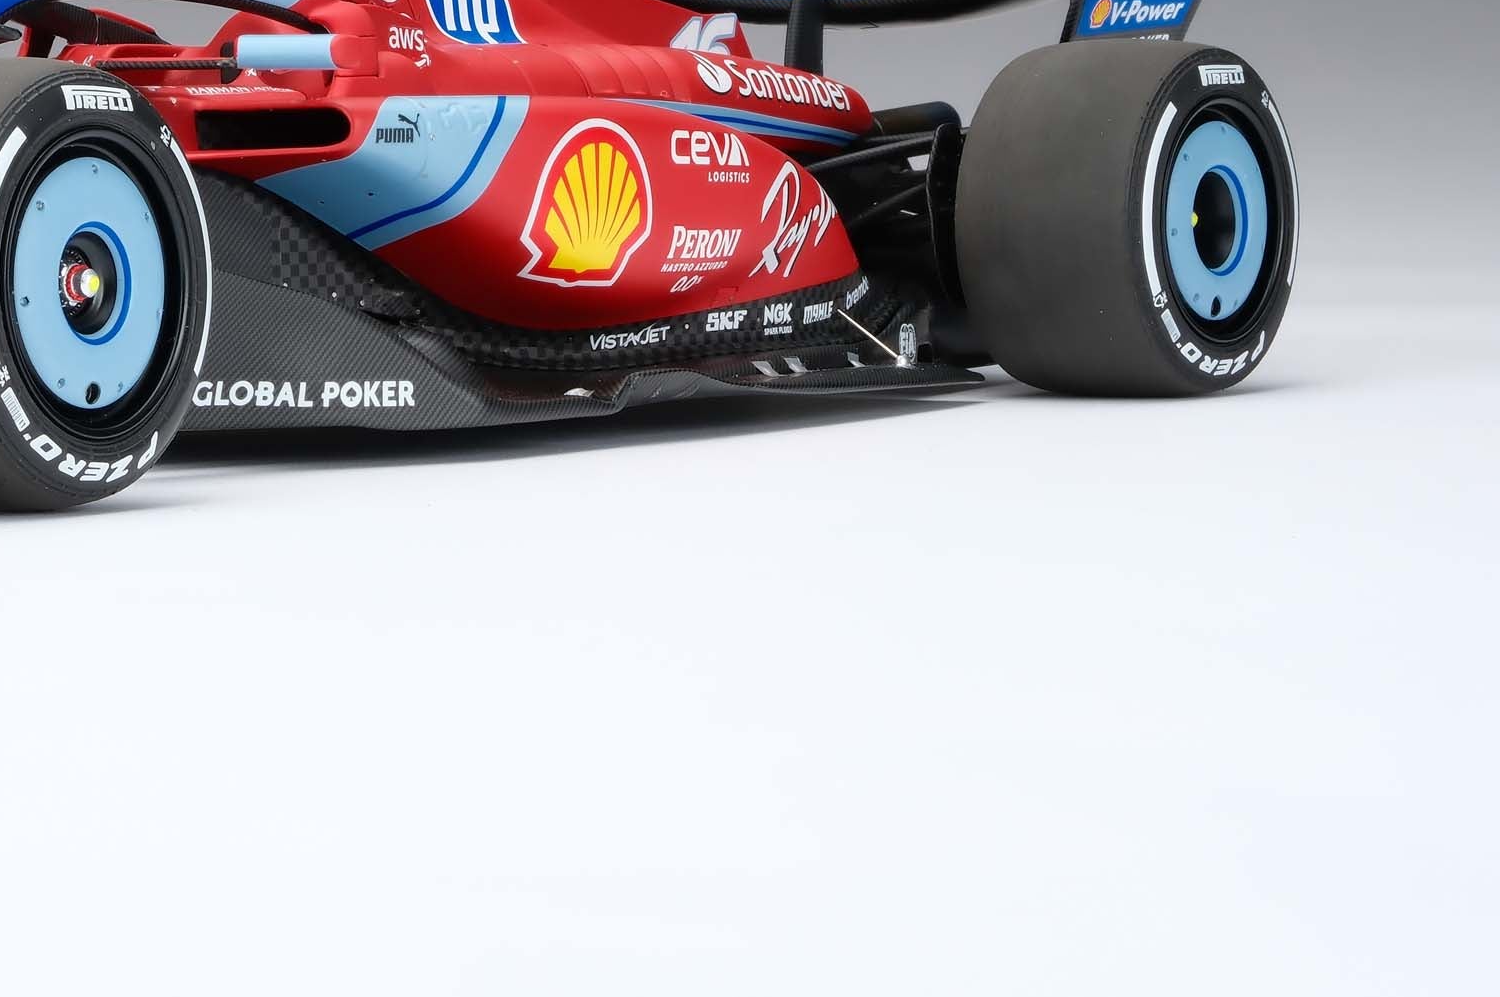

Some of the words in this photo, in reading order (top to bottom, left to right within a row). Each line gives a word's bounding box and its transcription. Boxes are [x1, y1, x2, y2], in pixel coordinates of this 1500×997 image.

[1110, 0, 1186, 26] V-Power
[388, 26, 425, 52] aws
[723, 59, 851, 112] Santander
[1198, 64, 1246, 87] PIRELLI
[60, 84, 134, 112] PIRELLI
[375, 127, 414, 144] PUMA
[707, 171, 750, 184] LOGISTICS
[666, 226, 742, 260] PERONI
[660, 263, 694, 273] NASTRO
[694, 260, 729, 272] AZZURRO
[705, 309, 748, 332] SKF
[763, 302, 794, 326] NGK
[802, 300, 834, 325] MAHLE
[1179, 341, 1249, 376] ZERO
[192, 380, 314, 408] GLOBAL
[321, 380, 416, 408] POKER
[29, 433, 134, 483] ZERO
[137, 430, 159, 470] P
